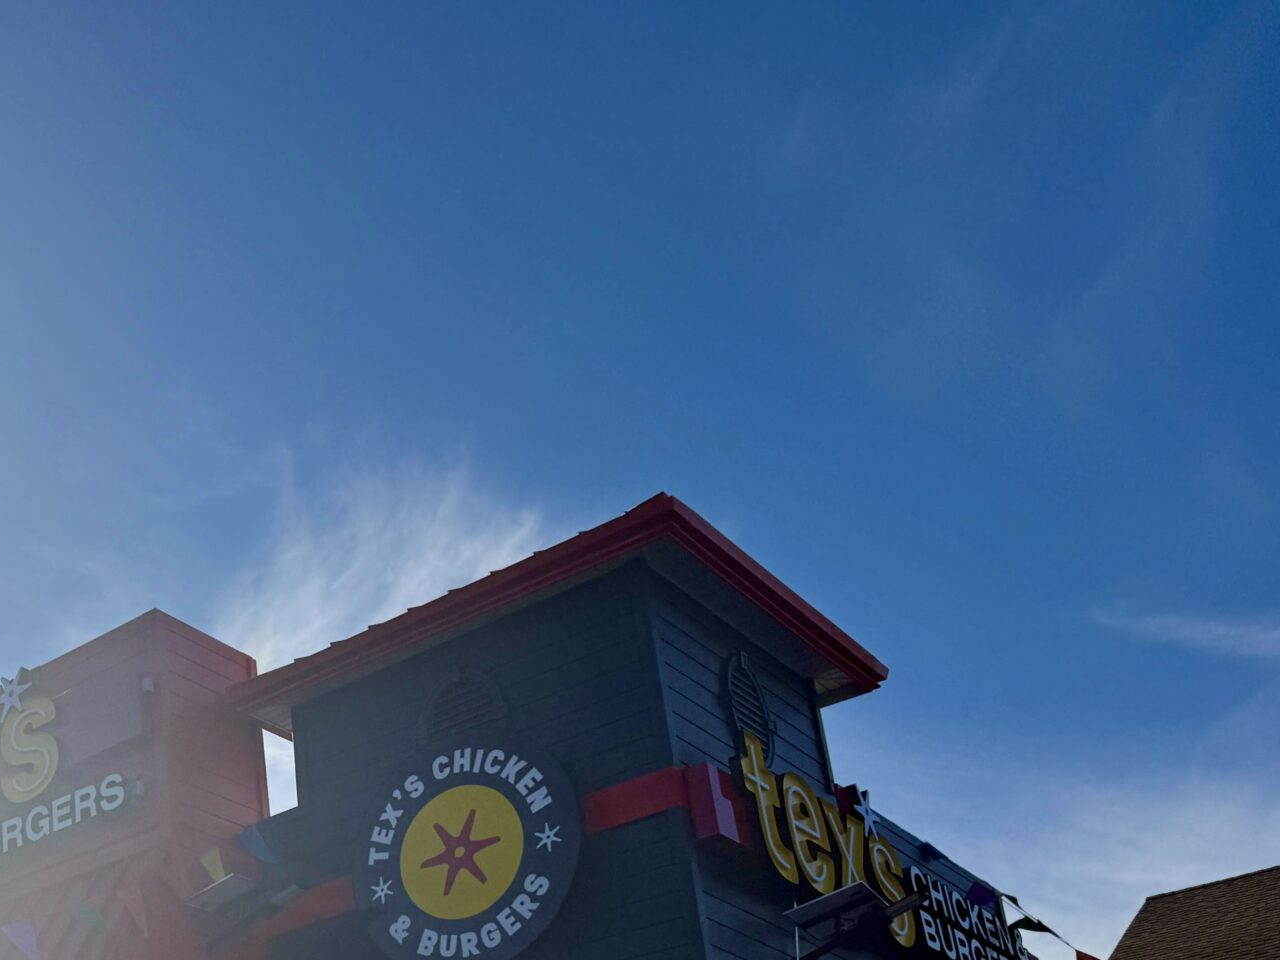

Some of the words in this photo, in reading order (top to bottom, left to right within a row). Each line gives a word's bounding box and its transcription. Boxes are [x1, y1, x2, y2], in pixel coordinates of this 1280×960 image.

[368, 774, 425, 866] TEX'S
[432, 748, 553, 814] CHICKEN
[389, 914, 411, 945] &
[416, 874, 550, 958] BURGERS
[910, 865, 1015, 957] CHICKEN
